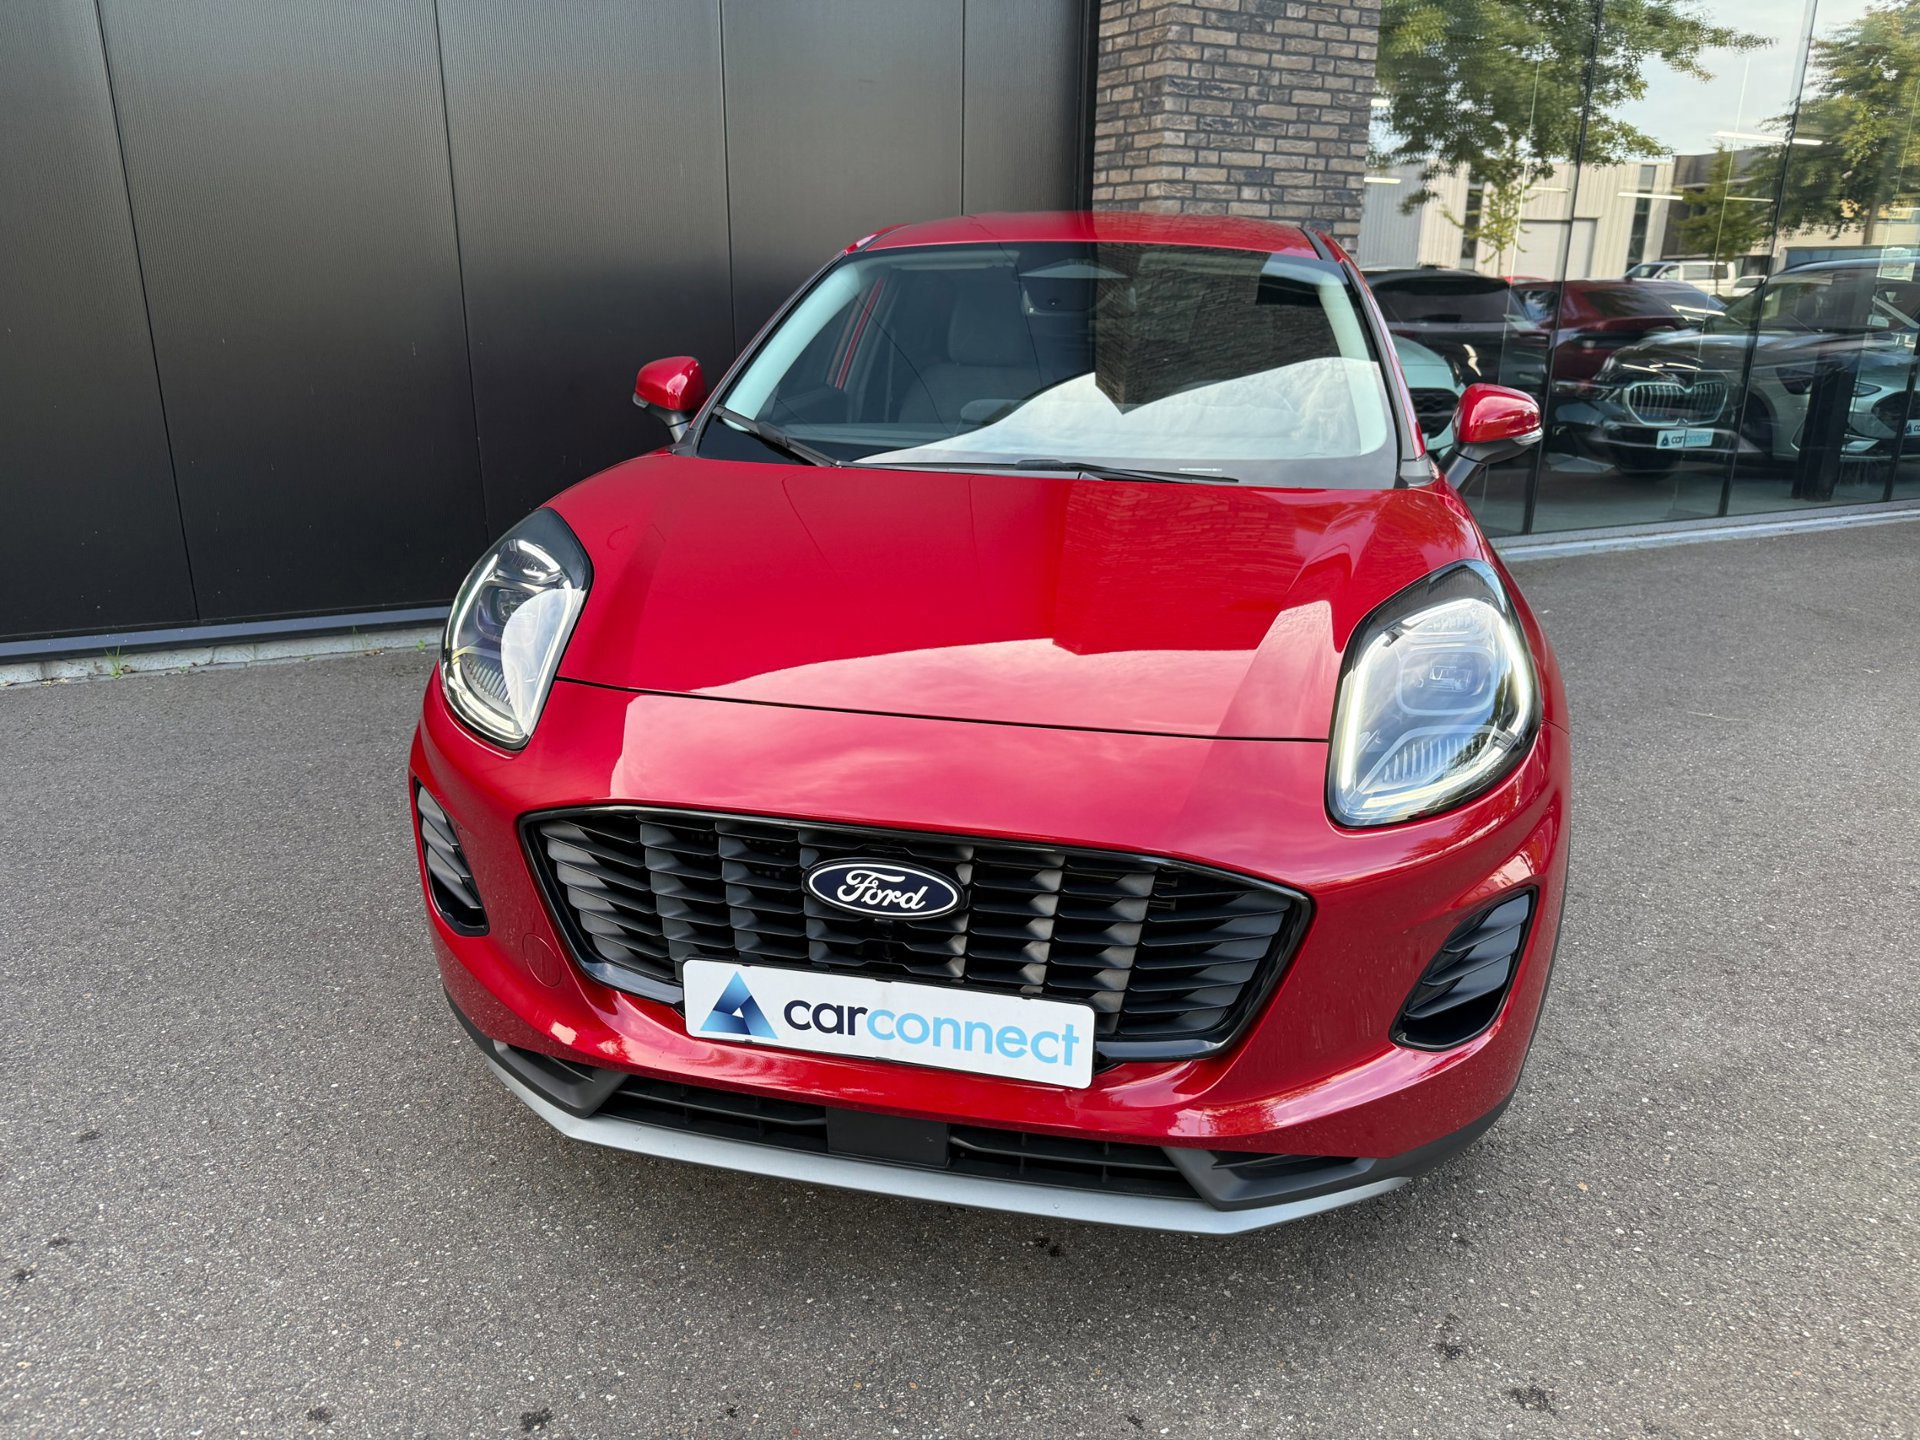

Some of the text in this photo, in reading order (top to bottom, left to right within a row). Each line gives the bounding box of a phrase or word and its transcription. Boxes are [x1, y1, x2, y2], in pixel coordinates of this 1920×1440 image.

[1671, 433, 1712, 444] caronnect
[836, 869, 929, 912] Ford
[783, 999, 1080, 1067] carconnect
